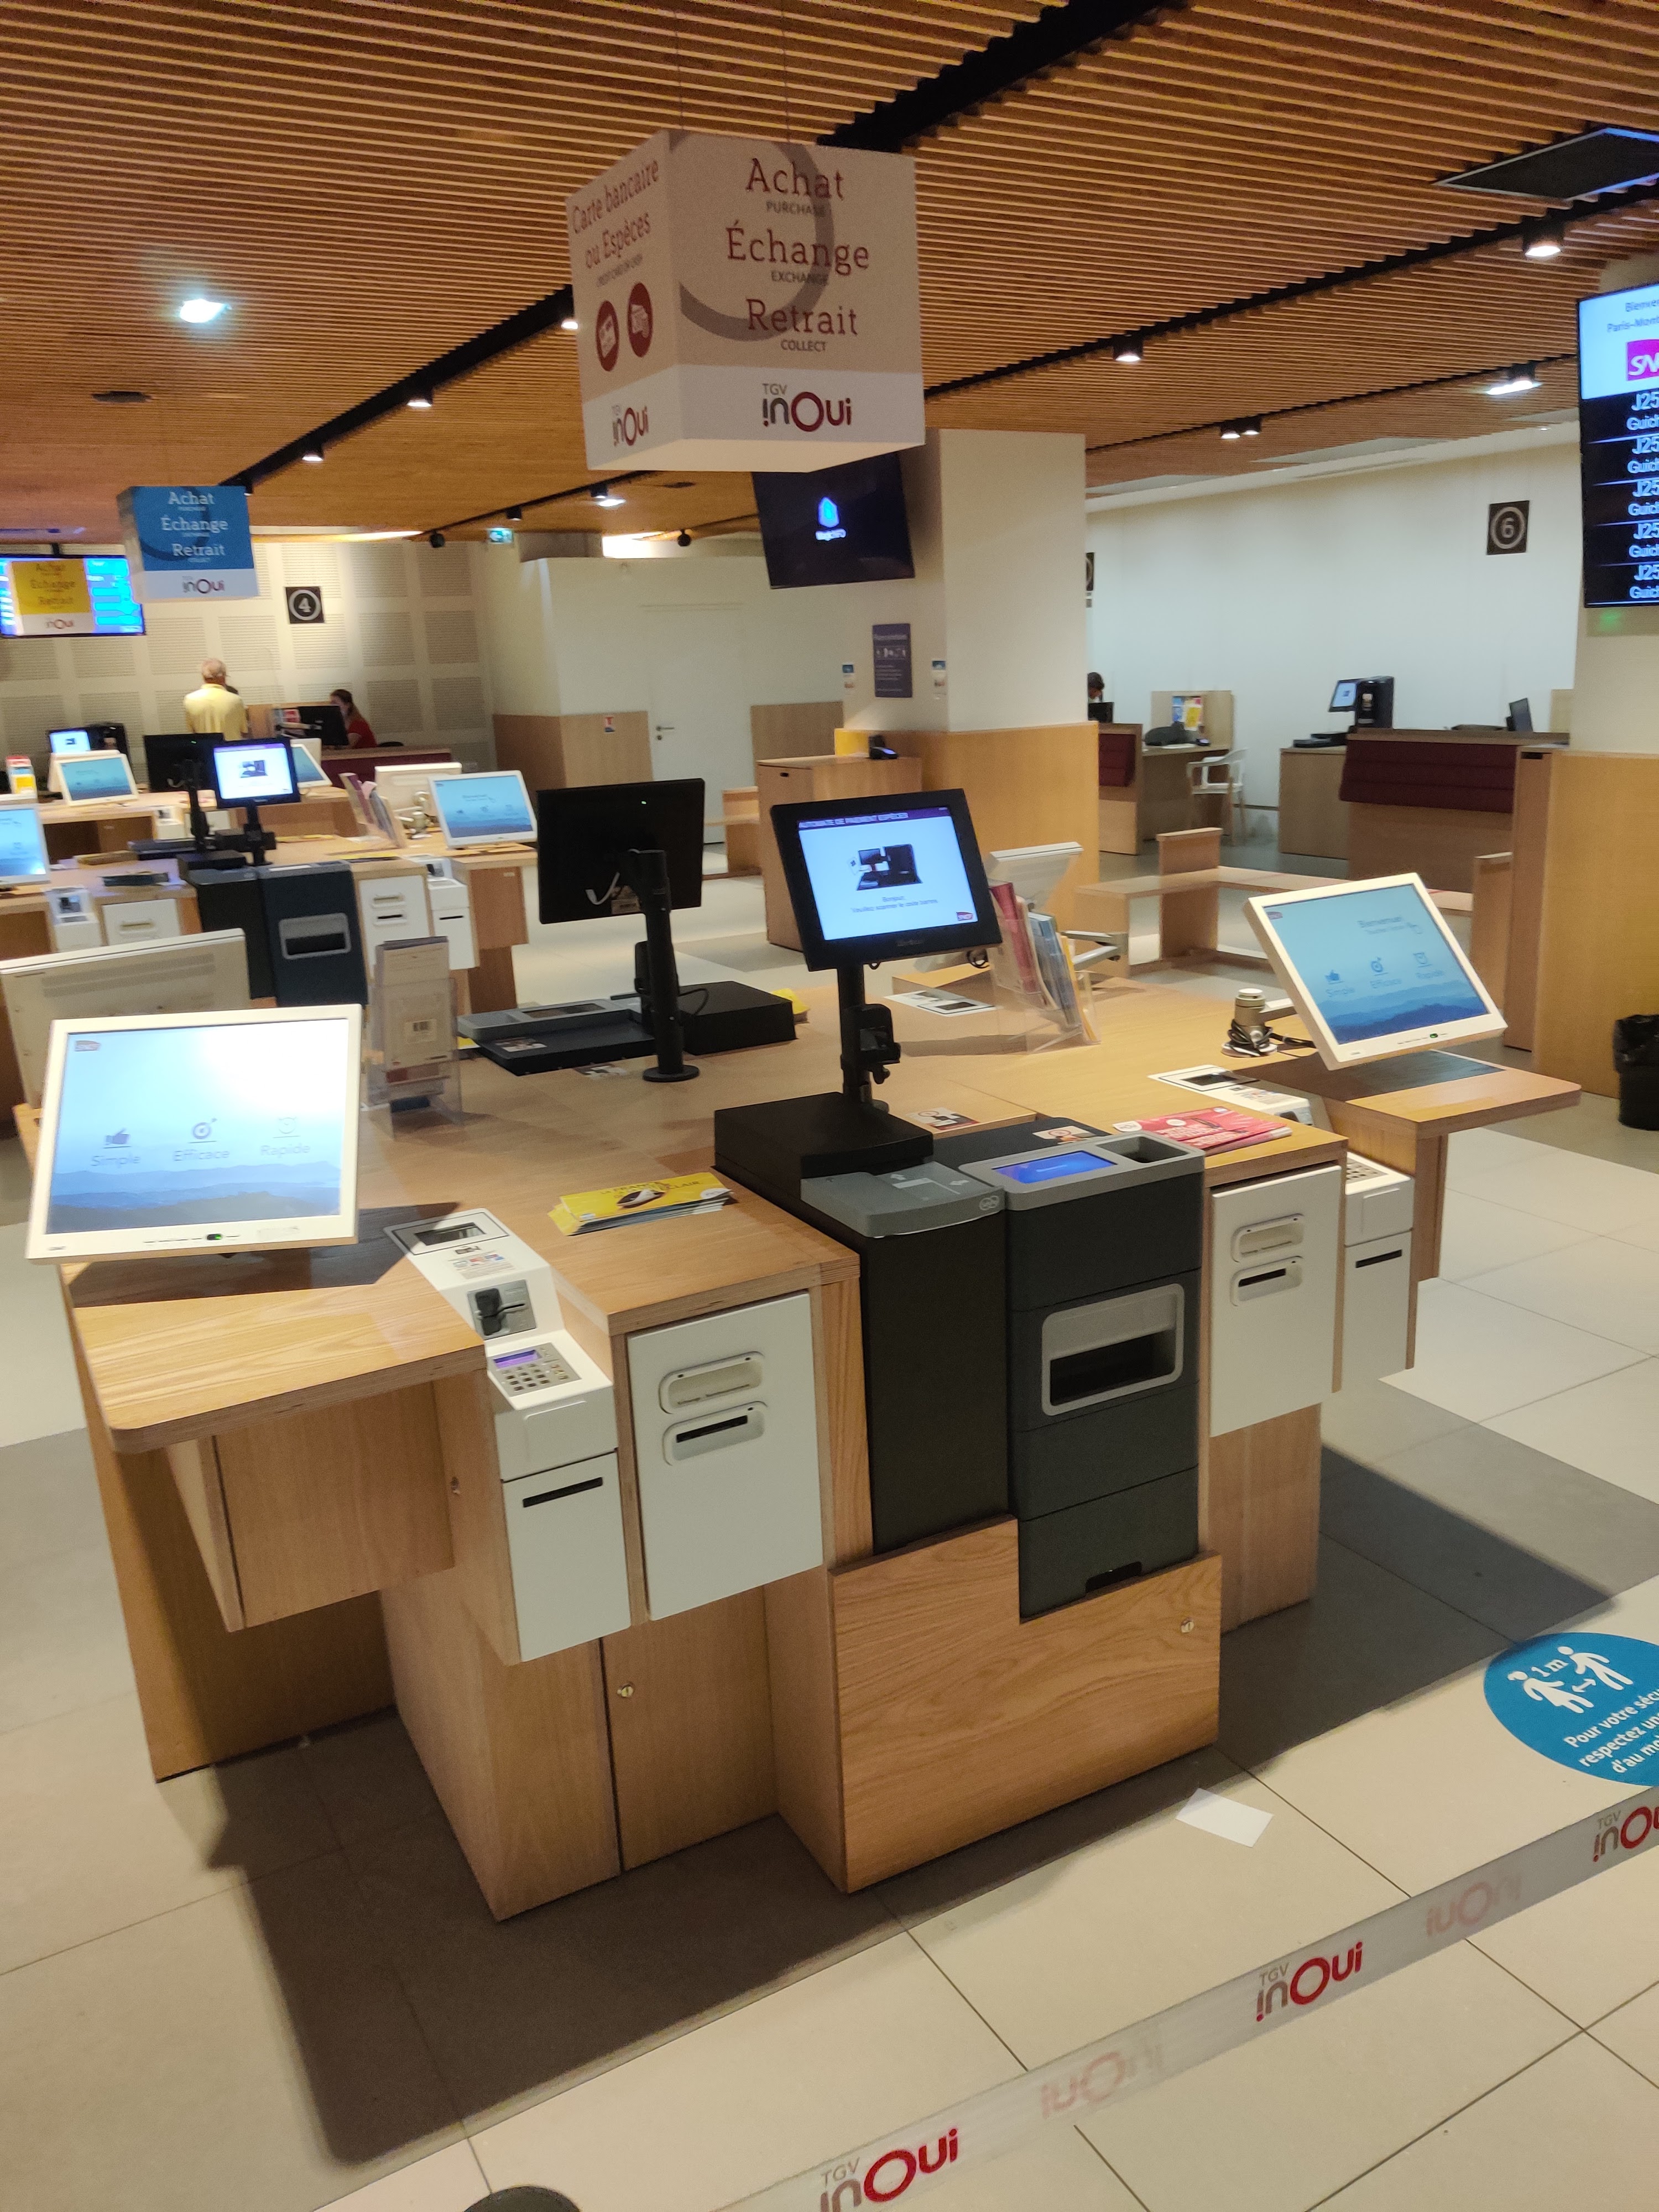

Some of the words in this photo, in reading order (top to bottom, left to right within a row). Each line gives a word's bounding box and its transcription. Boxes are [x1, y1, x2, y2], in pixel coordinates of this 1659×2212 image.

[745, 158, 844, 201] Achat
[573, 199, 602, 234] Carte
[604, 160, 659, 212] bancaire
[765, 200, 827, 217] PURCHASE
[585, 244, 600, 269] ou
[602, 212, 651, 259] Espèces
[726, 220, 869, 276] Échange
[747, 299, 858, 336] Retrait
[780, 340, 827, 352] COLLECT
[762, 383, 787, 395] TGV
[168, 491, 216, 505] Achat
[160, 514, 229, 534] Échange
[1501, 518, 1515, 539] 6
[171, 542, 226, 556] Retrait
[299, 598, 312, 613] 4
[91, 1152, 141, 1168] Simple
[174, 1147, 231, 1162] Efficace
[260, 1143, 311, 1159] Rapide
[1531, 1666, 1551, 1677] 1
[1544, 1659, 1569, 1672] m
[1563, 1726, 1602, 1748] Pour
[1598, 1707, 1639, 1728] votre
[1578, 1726, 1647, 1767] respectez
[1640, 1713, 1659, 1729] un
[1611, 1753, 1646, 1773] d'au
[1598, 1810, 1621, 1830] TGV
[1259, 1962, 1290, 1987] TGV
[821, 2157, 860, 2187] TGV
